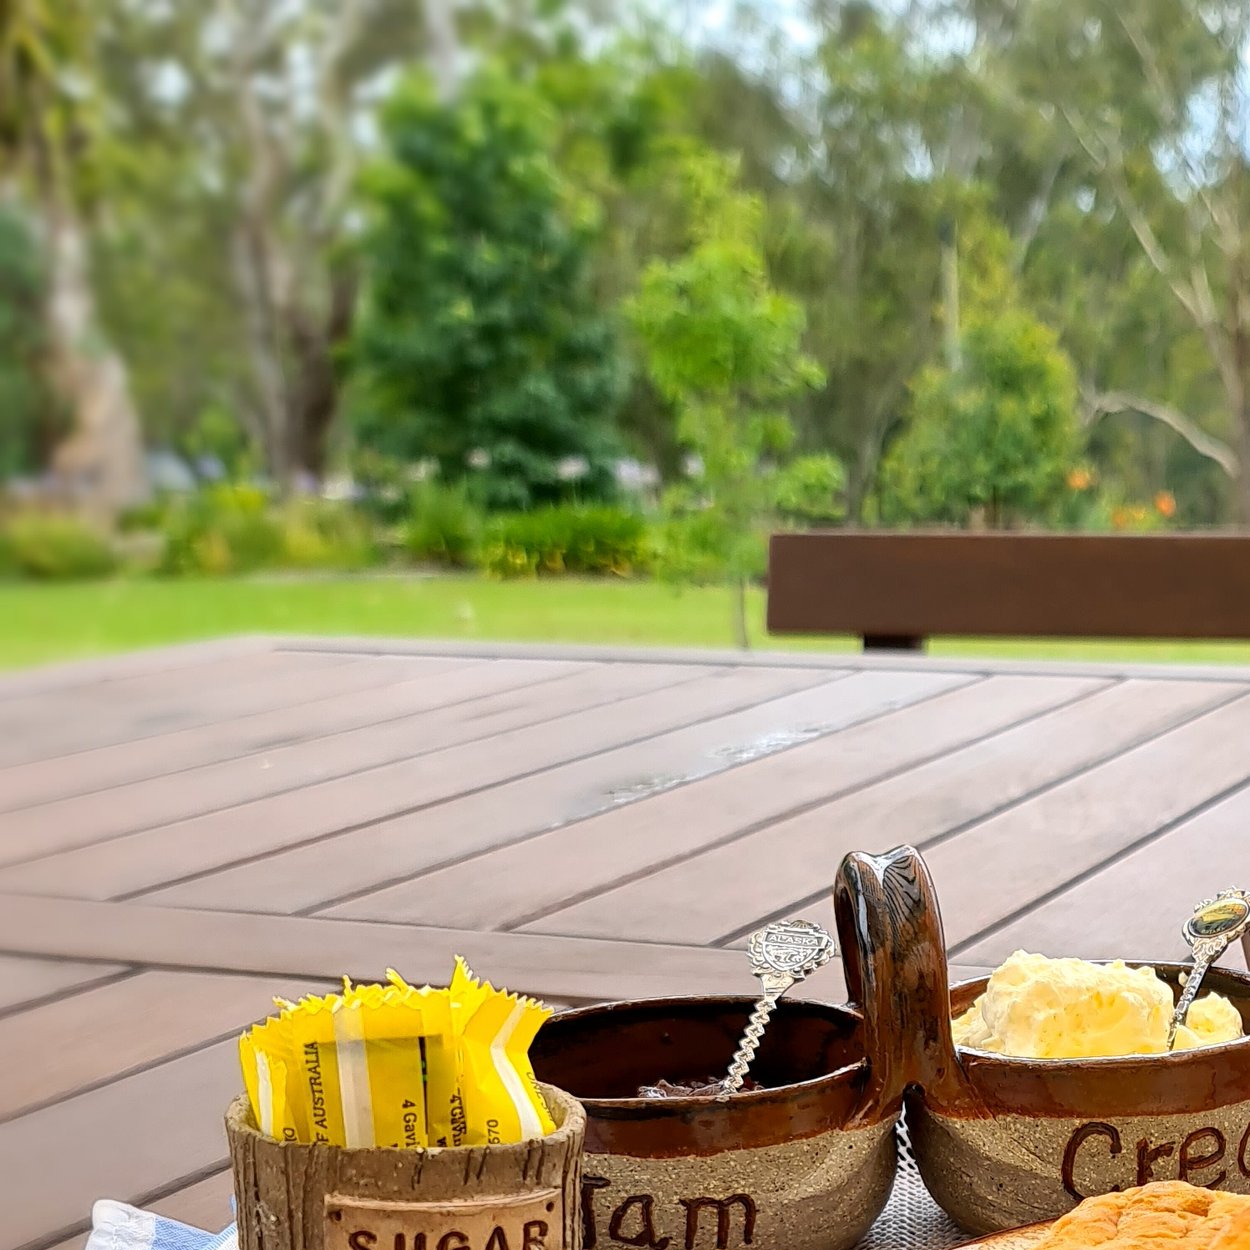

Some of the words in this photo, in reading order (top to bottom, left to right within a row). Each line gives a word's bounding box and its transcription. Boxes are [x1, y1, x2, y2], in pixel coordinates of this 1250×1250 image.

[769, 934, 819, 946] ALASKA
[303, 1041, 328, 1130] AUSTRALIA
[402, 1112, 420, 1148] Gavi
